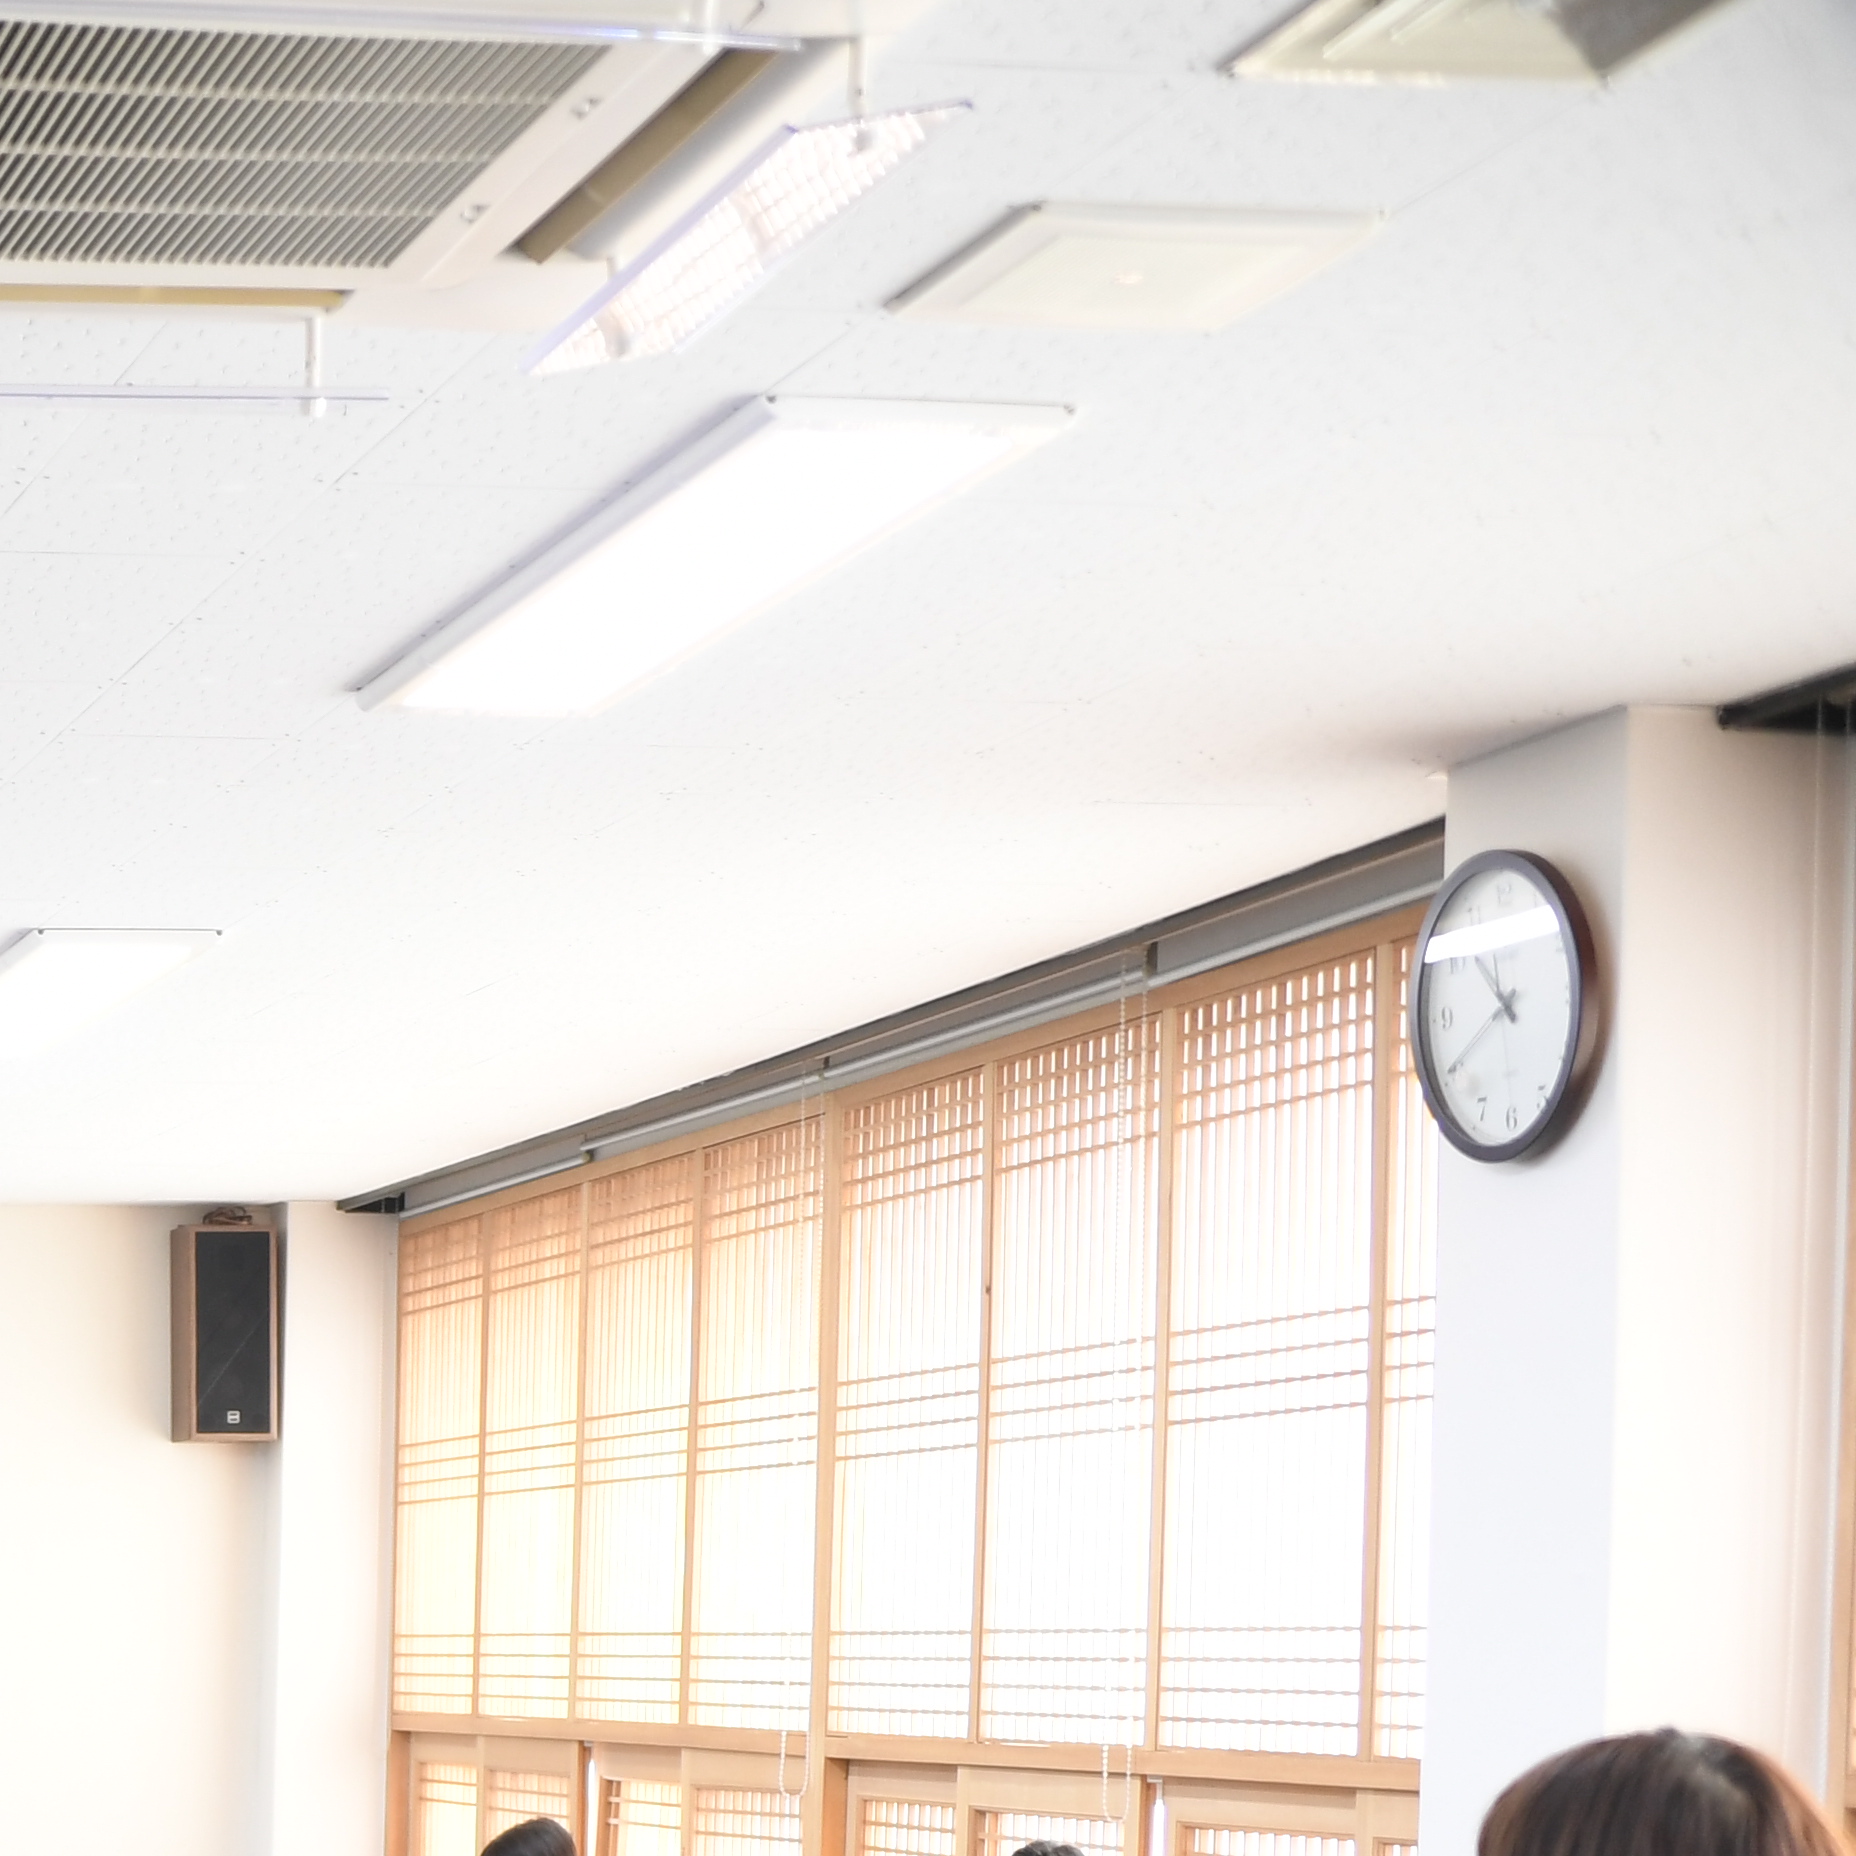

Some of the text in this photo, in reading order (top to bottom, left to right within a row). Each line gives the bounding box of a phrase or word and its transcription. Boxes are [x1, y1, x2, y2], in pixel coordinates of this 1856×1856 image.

[1440, 1007, 1453, 1030] 9
[1476, 1096, 1488, 1122] 7
[1505, 1106, 1518, 1131] 6
